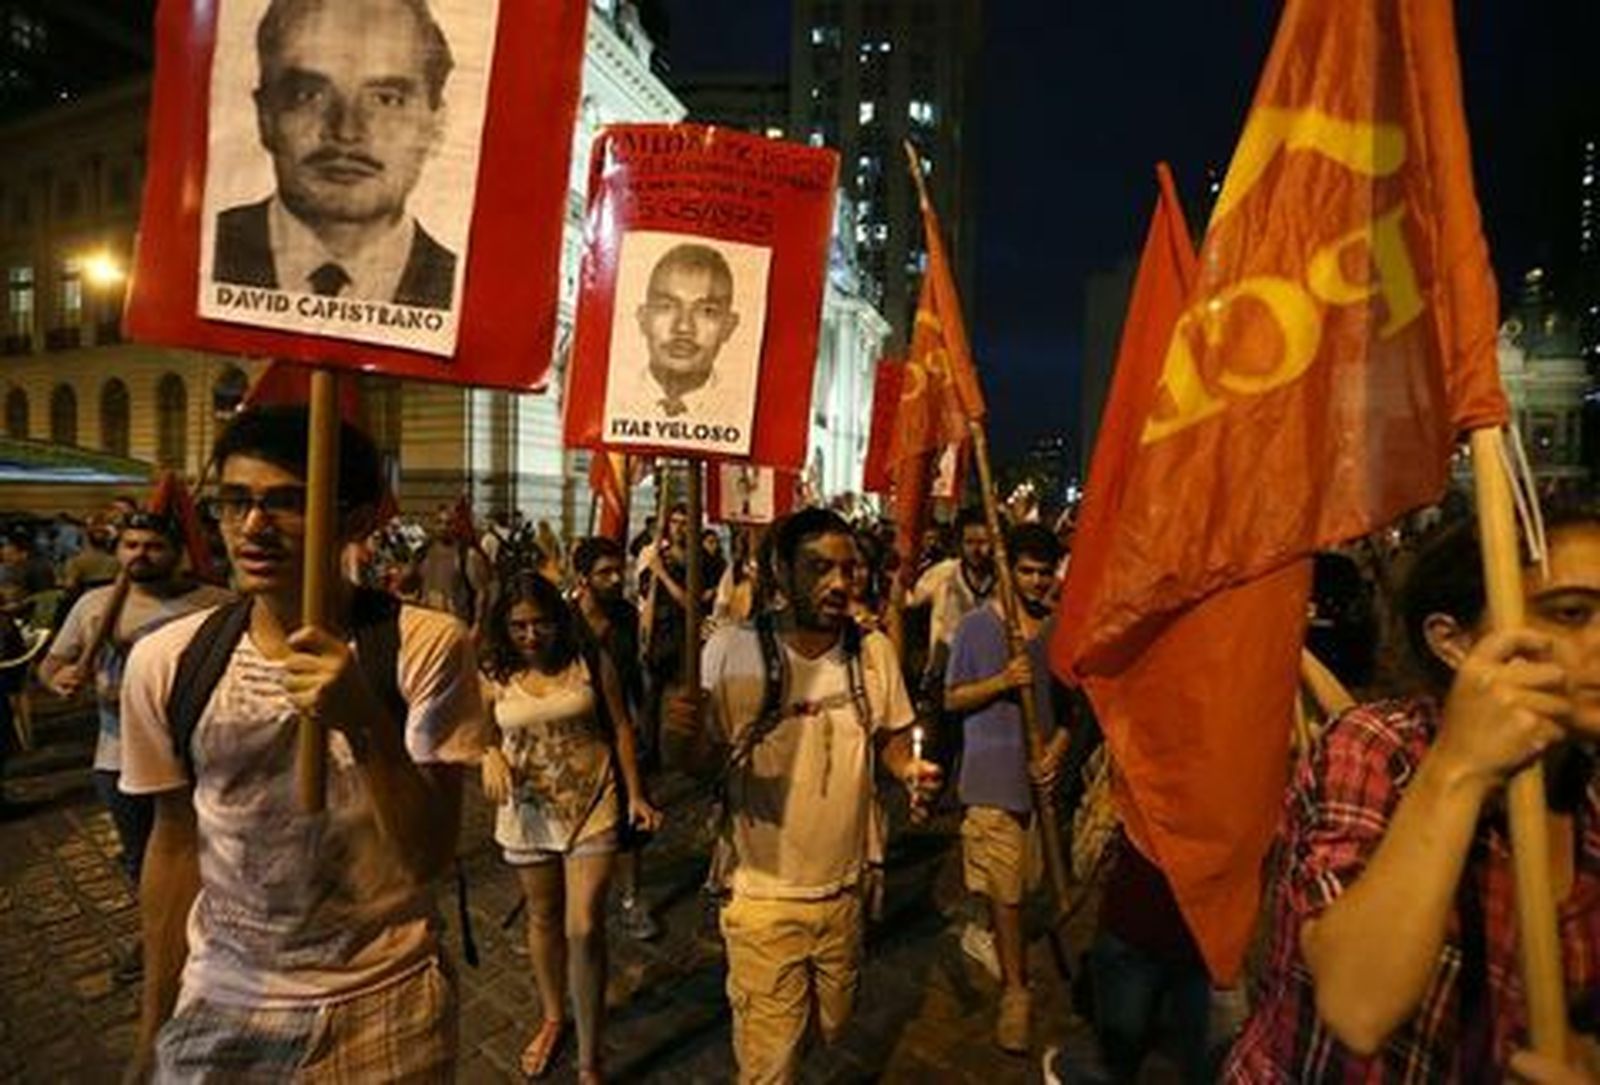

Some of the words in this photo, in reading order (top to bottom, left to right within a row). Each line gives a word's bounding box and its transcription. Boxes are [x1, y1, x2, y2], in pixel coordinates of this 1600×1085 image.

[216, 287, 290, 313] DAVID
[296, 296, 444, 332] CAPISTRANO
[655, 420, 741, 443] VELOSO
